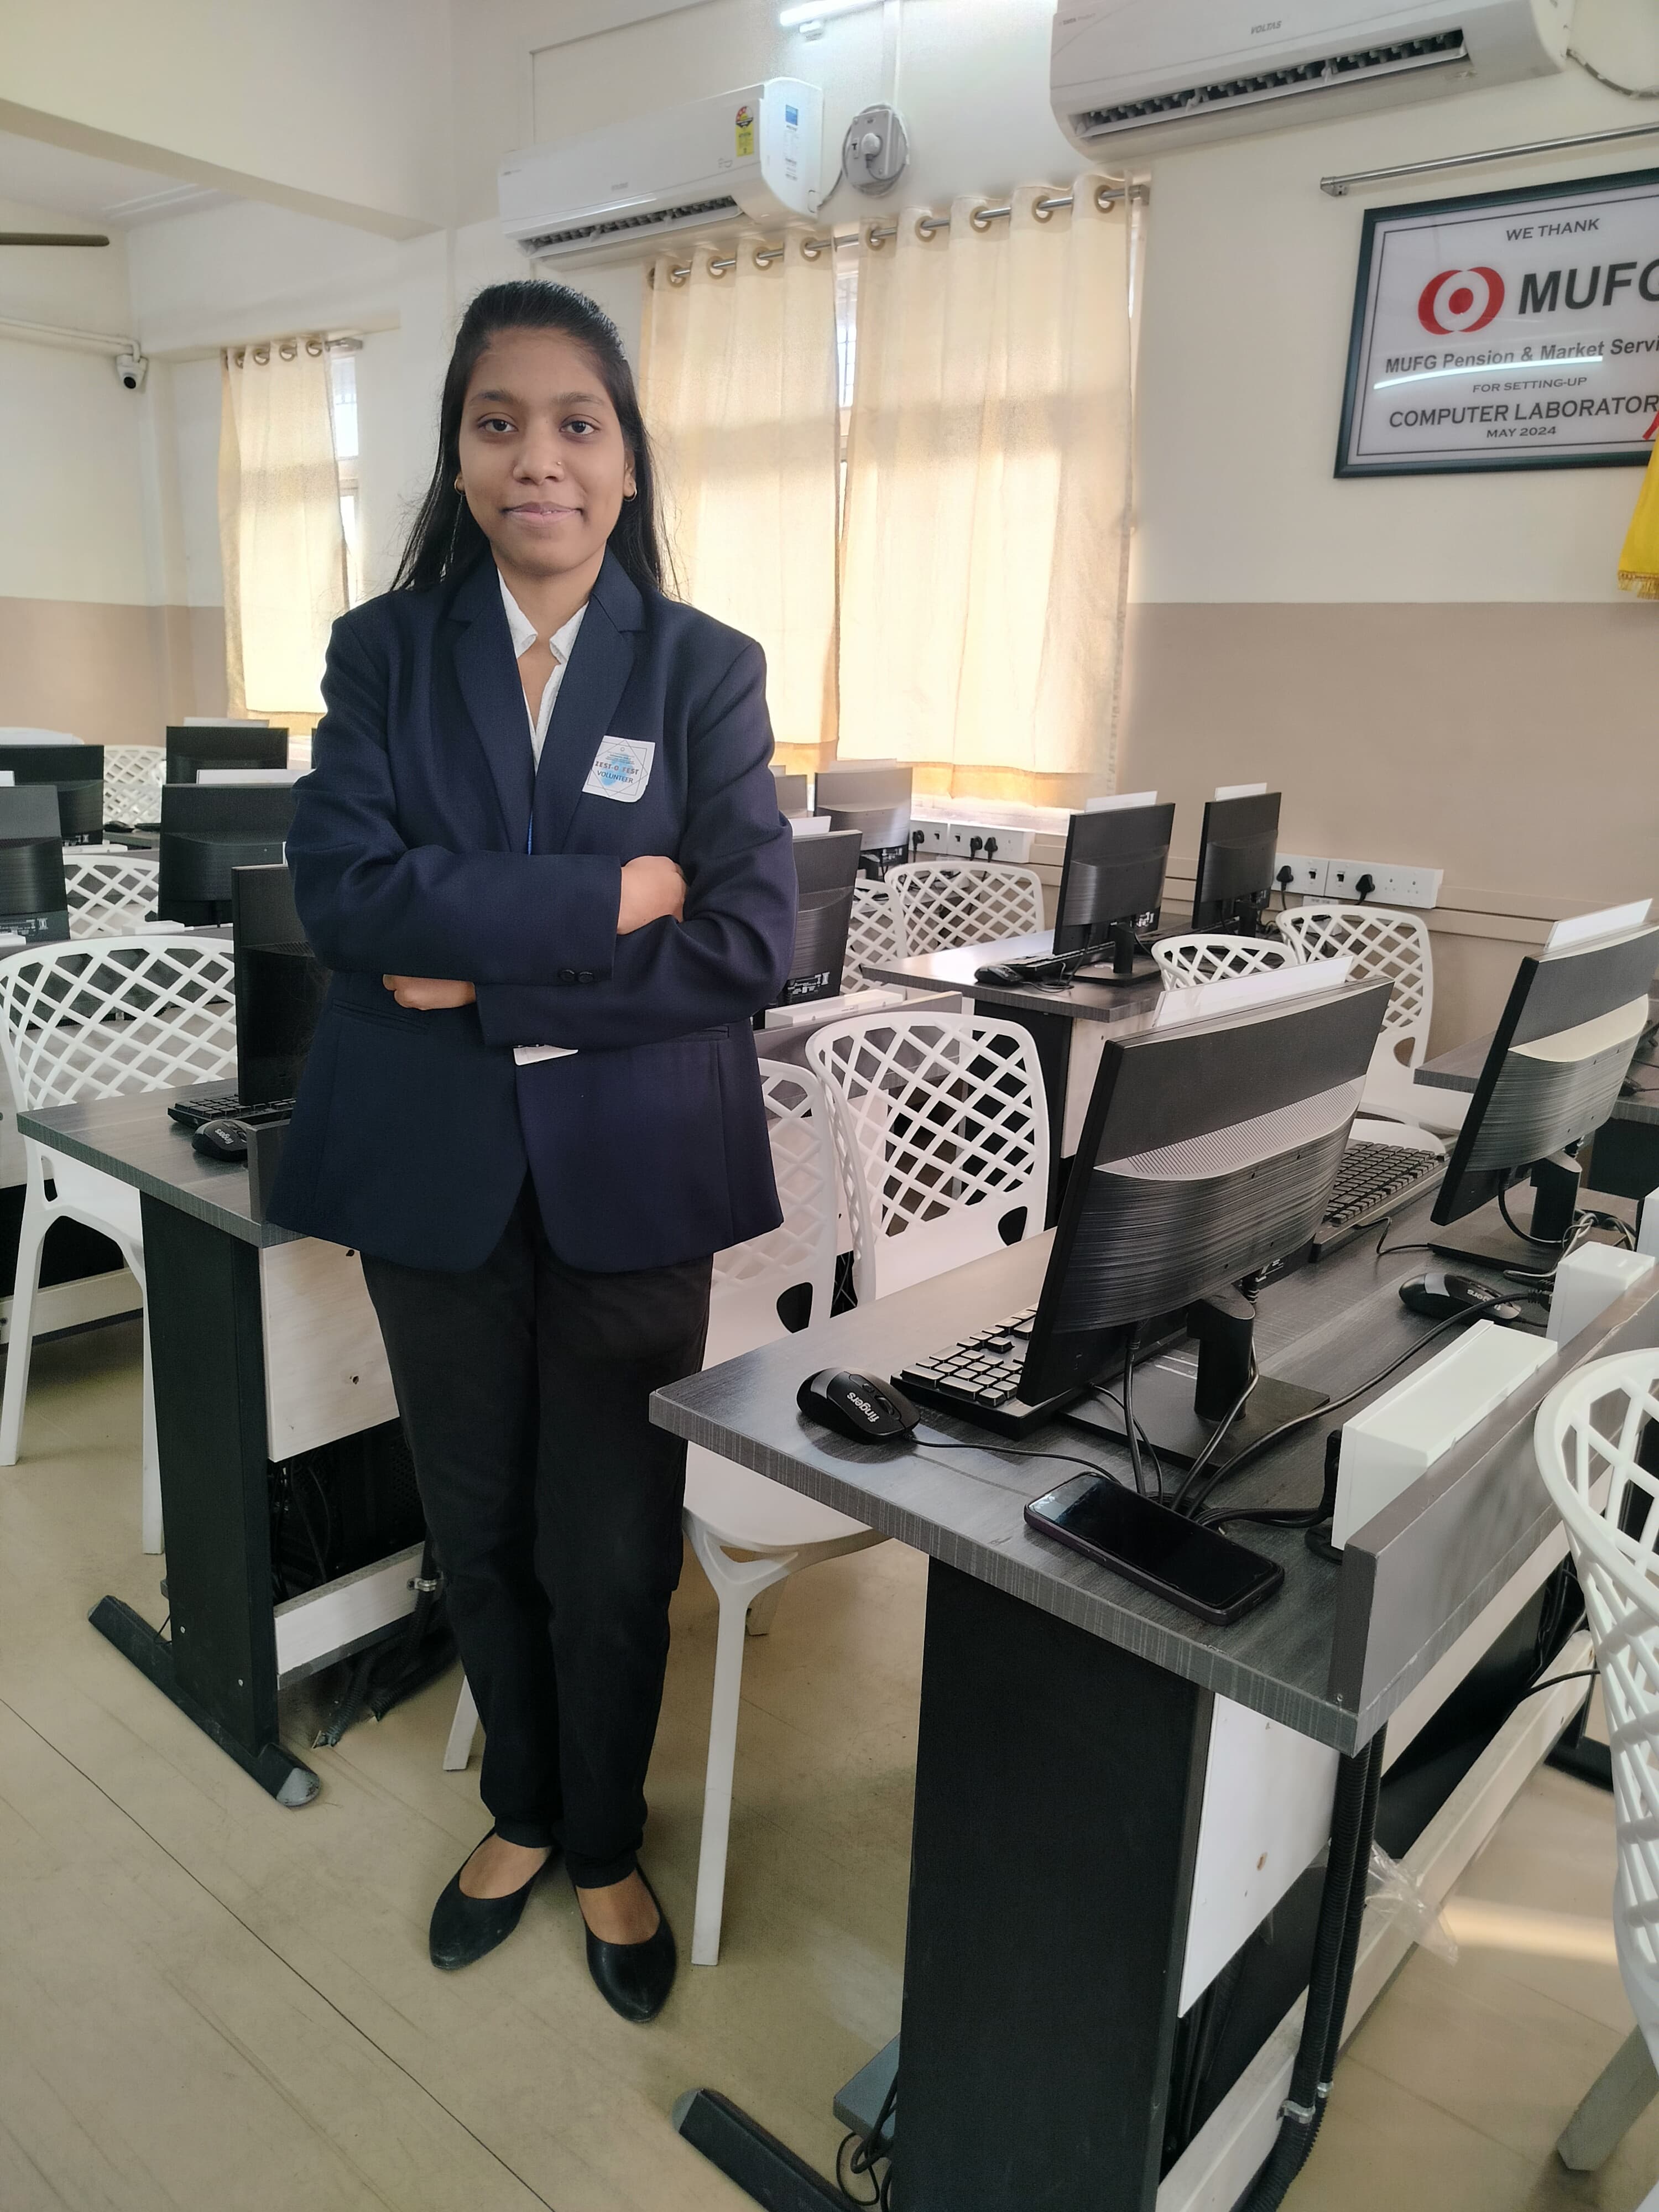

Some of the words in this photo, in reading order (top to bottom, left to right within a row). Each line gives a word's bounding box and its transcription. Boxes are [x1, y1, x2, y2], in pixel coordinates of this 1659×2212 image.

[1251, 20, 1282, 34] VOLTAS
[1506, 227, 1533, 241] WE
[1538, 218, 1600, 237] THANK
[1385, 354, 1437, 373] MUFG
[1443, 349, 1514, 368] Pension
[1521, 346, 1533, 362] &
[1540, 341, 1604, 360] Market
[1473, 383, 1500, 393] FOR
[1504, 377, 1587, 392] SETTING-UP
[1389, 404, 1509, 427] COMPUTER
[1514, 394, 1659, 420] LABORATOR
[1486, 428, 1517, 438] MAY
[1520, 426, 1557, 436] 2024
[597, 770, 634, 784] VOLUNTEER
[622, 766, 639, 775] FEST
[215, 1128, 234, 1144] fingers
[847, 1392, 880, 1422] fingers
